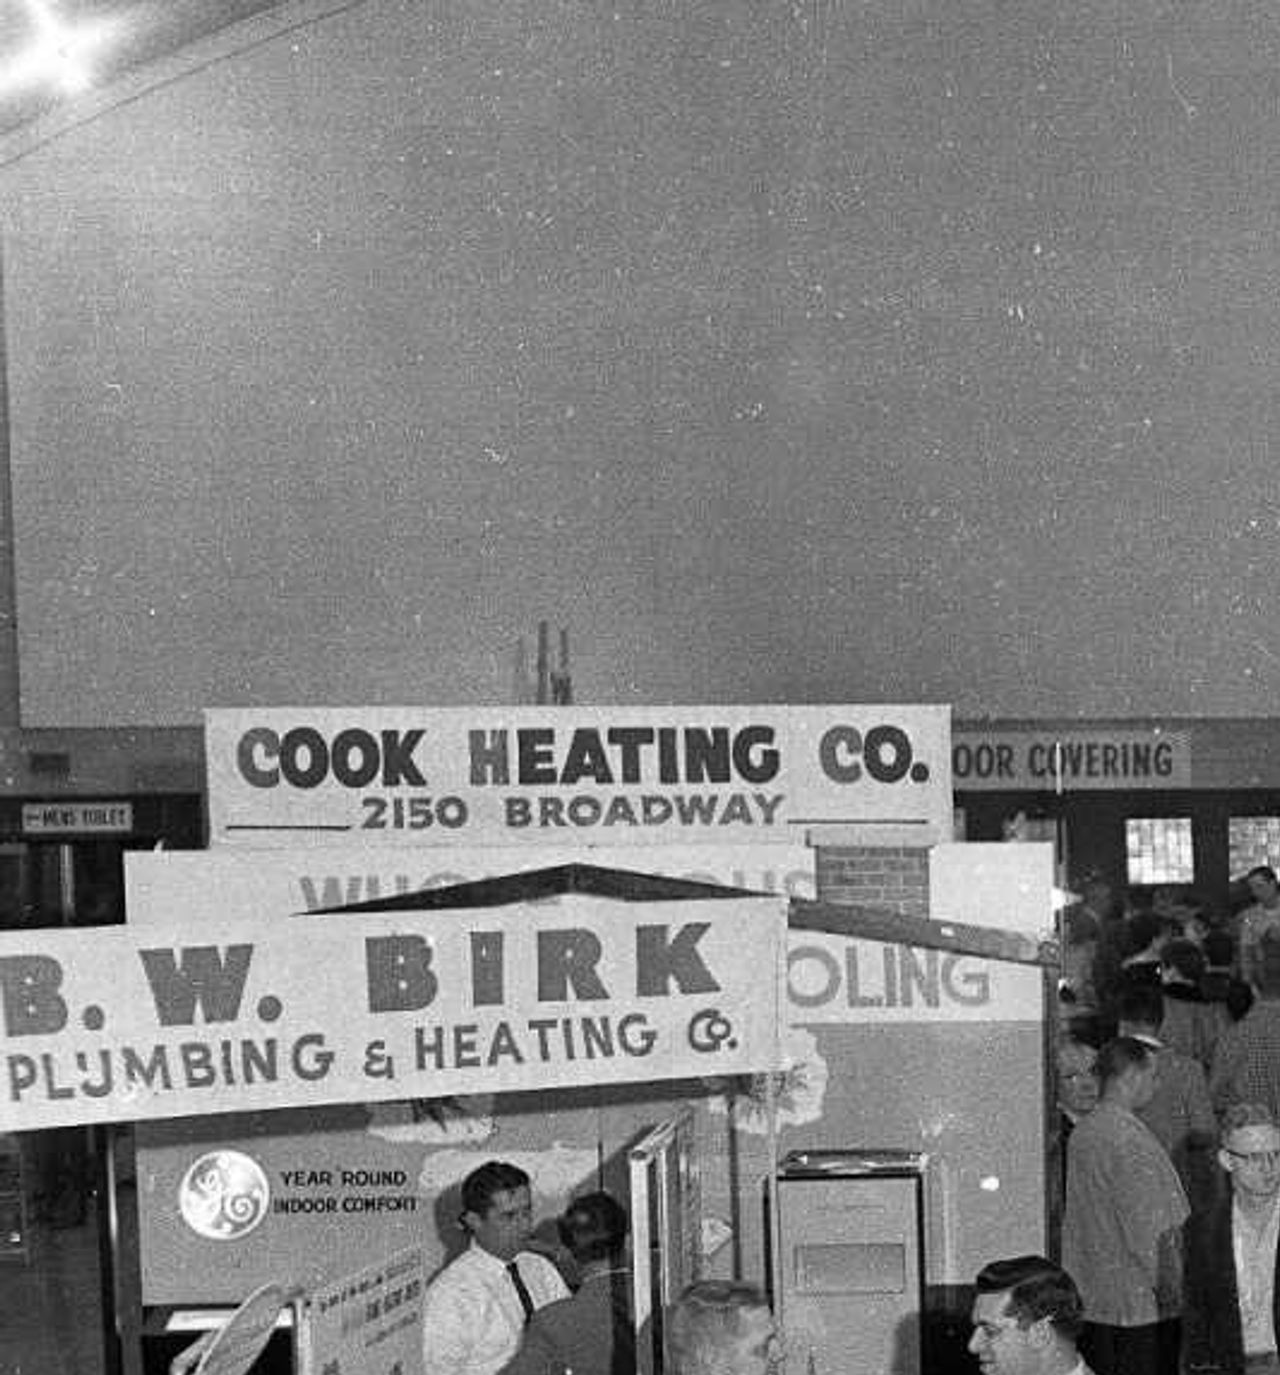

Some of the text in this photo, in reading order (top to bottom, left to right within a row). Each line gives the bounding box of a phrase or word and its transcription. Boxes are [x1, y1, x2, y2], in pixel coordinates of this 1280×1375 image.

[237, 724, 930, 789] COOK HEATING CO.
[952, 742, 1172, 777] OOR COVERING
[361, 794, 785, 829] 2150 BROADWAY
[0, 921, 722, 1037] B. W. BIRK
[787, 945, 990, 1009] OLING
[6, 1033, 335, 1101] PLUMBING
[363, 1039, 394, 1080] &
[415, 1012, 657, 1071] HEATING
[281, 1170, 407, 1187] YEAR ROUND
[274, 1196, 417, 1214] INDOOR COMFORT
